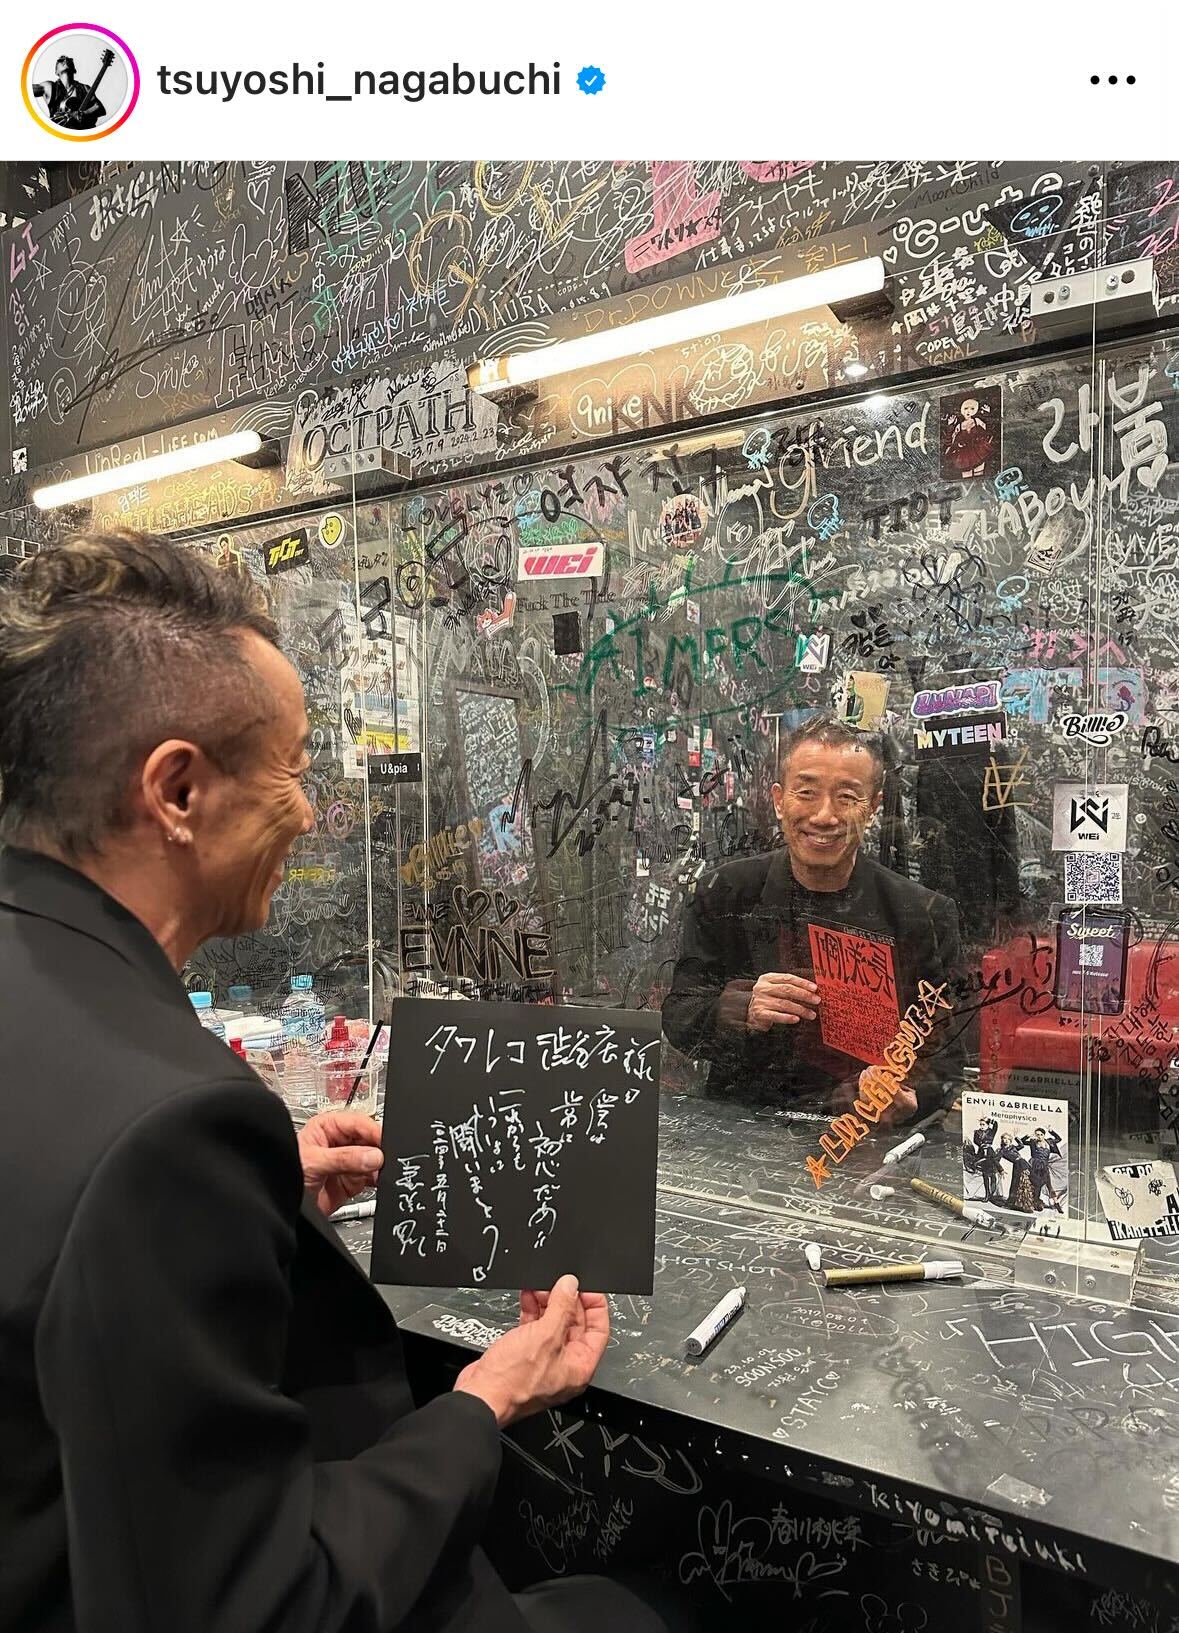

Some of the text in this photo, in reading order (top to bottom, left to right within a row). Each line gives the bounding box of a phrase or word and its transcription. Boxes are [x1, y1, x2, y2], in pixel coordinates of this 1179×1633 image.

[469, 293, 554, 335] DIAURA
[915, 722, 1002, 750] MYTEEN
[380, 763, 408, 776] U&pia
[966, 1096, 1063, 1113] ENVii GABRIELLA
[661, 1254, 783, 1278] HOTSHOT
